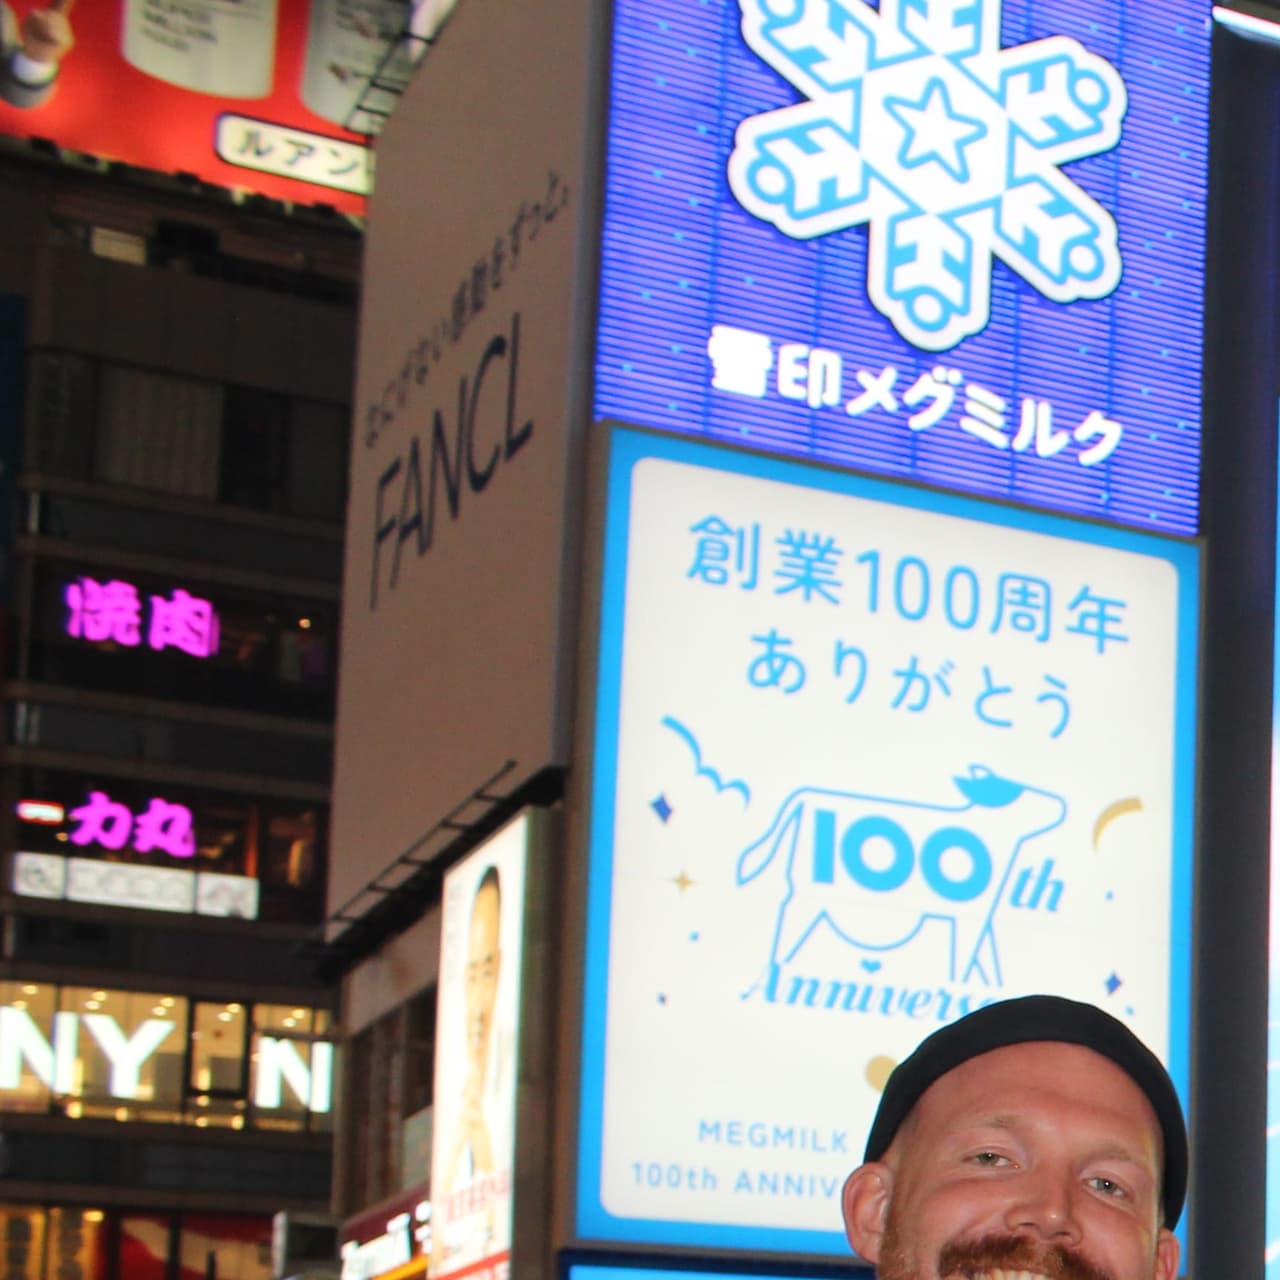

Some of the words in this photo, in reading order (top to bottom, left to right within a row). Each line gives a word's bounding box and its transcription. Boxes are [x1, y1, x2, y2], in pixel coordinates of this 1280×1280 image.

[236, 128, 373, 180] ルアン
[707, 325, 1123, 466] 雪印メグミルク
[369, 311, 535, 613] FANCL
[66, 577, 219, 657] 焼肉
[685, 514, 1130, 655] 創業100周年
[745, 628, 1071, 739] ありがとう
[70, 791, 196, 858] 力丸
[632, 1160, 718, 1192] 100th
[697, 1119, 849, 1153] MEGMILK
